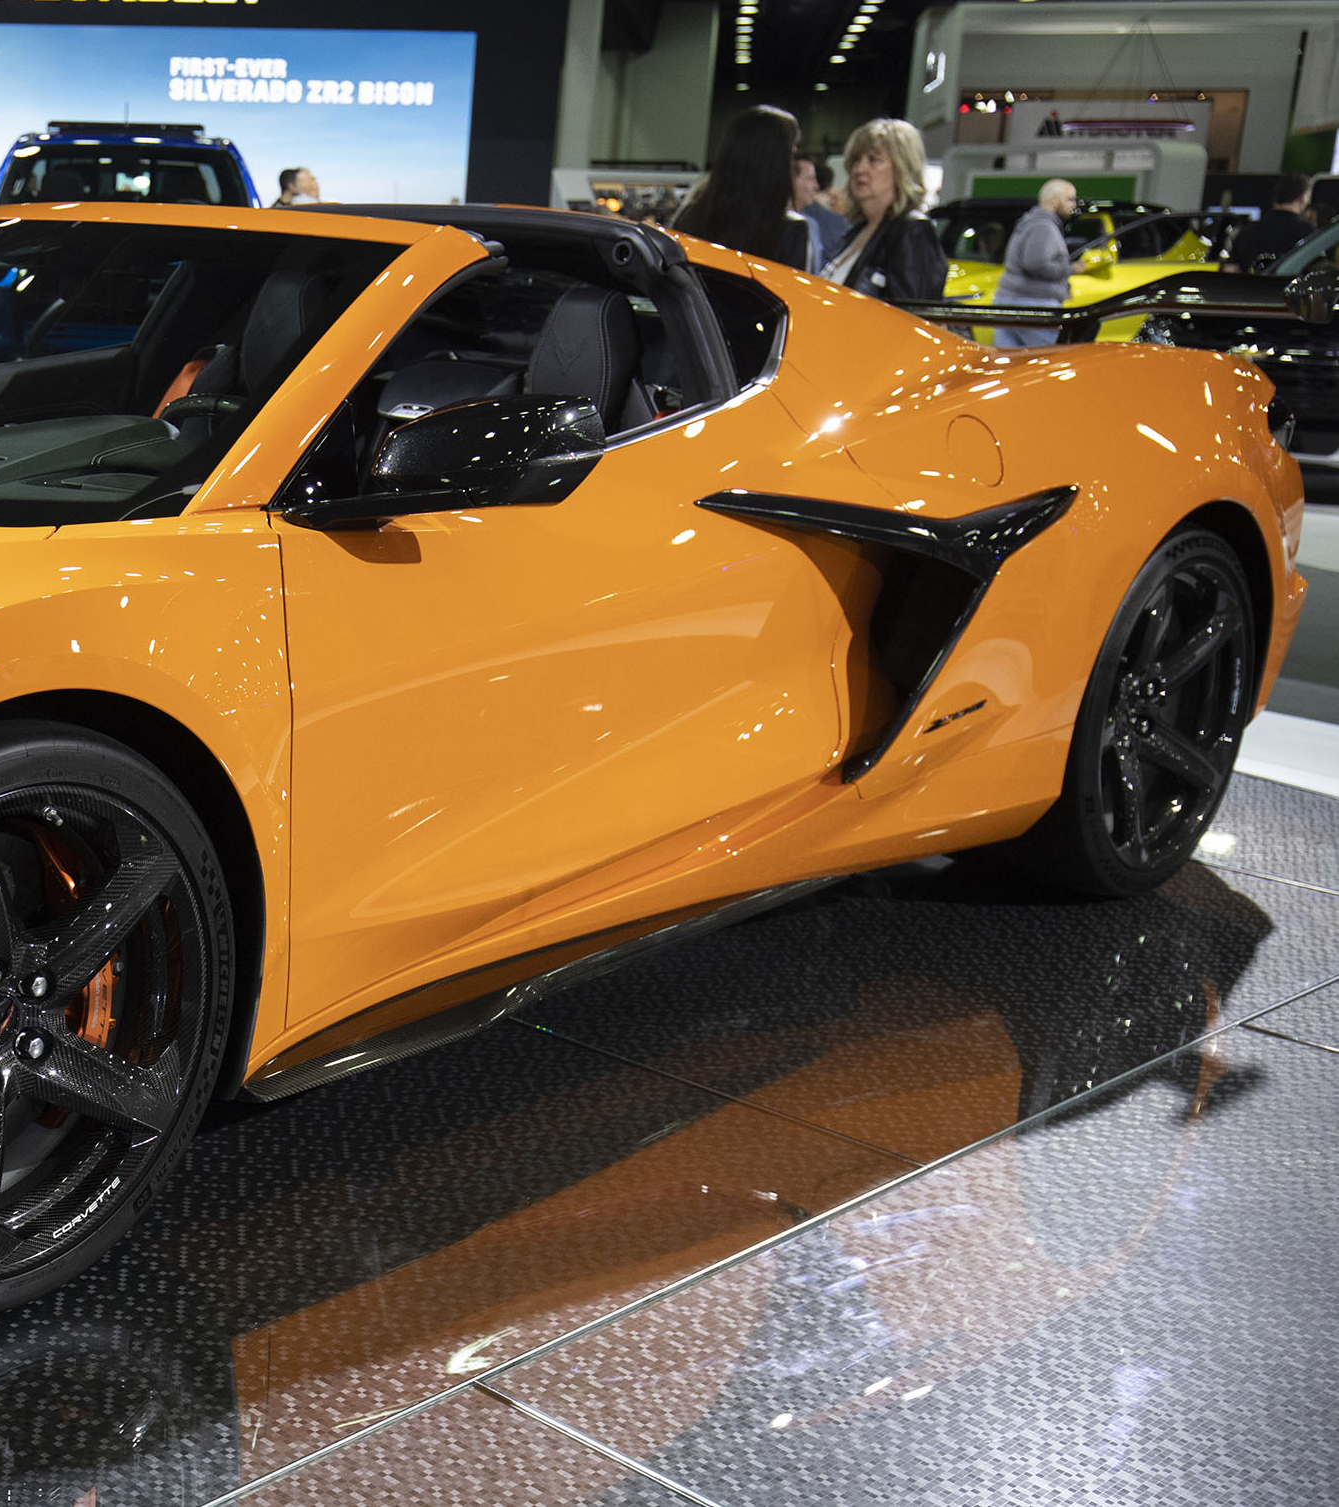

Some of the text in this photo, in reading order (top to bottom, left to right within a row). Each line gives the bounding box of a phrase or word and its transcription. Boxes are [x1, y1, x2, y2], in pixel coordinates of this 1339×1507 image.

[169, 56, 288, 79] FIRST-EVER
[168, 78, 434, 107] SILVERADO ZR2 BISON
[211, 933, 232, 1052] MICHELIN
[53, 1177, 121, 1239] CORVETTE
